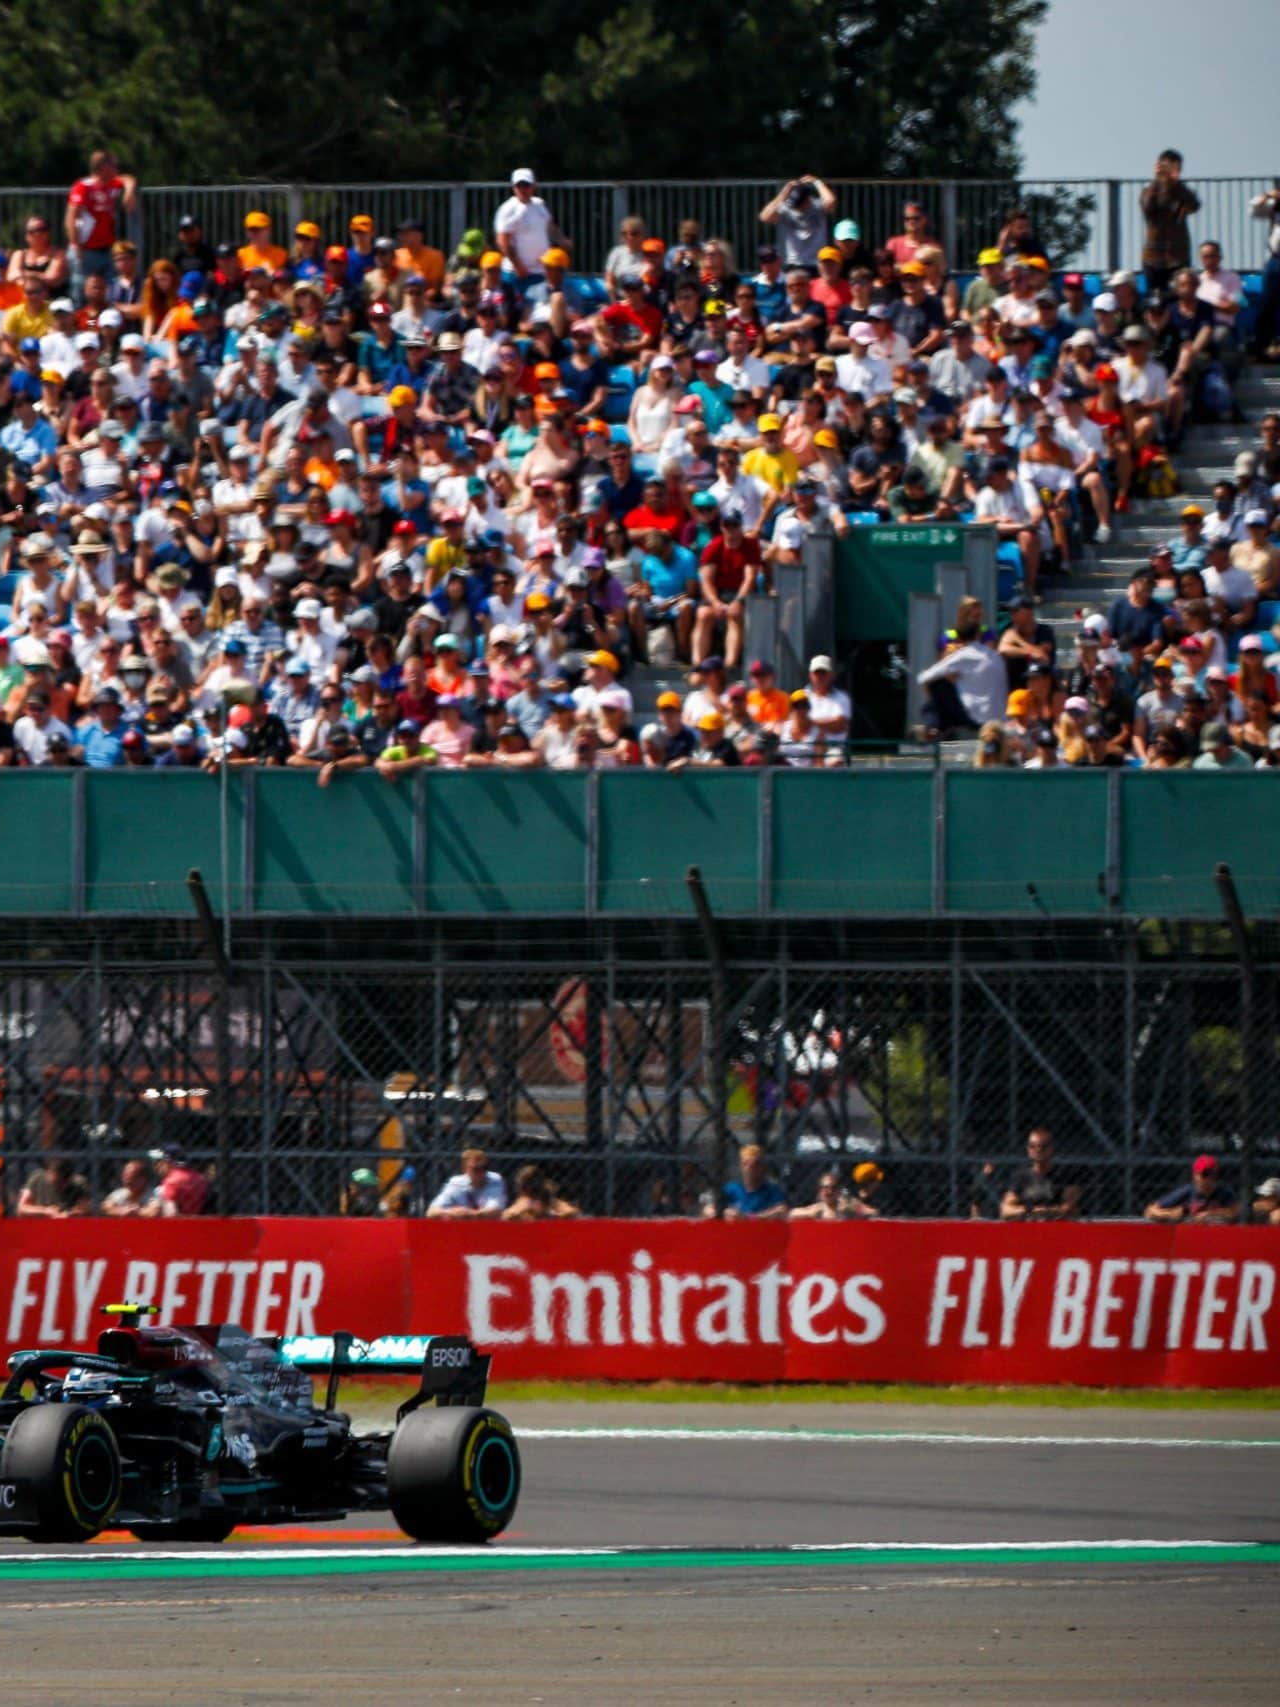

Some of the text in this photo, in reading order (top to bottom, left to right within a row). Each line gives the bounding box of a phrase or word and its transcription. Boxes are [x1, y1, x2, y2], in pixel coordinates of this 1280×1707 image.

[7, 1258, 107, 1342] FLY
[464, 1249, 1276, 1351] Emirates FLY BETTER
[431, 1347, 471, 1367] EPSON
